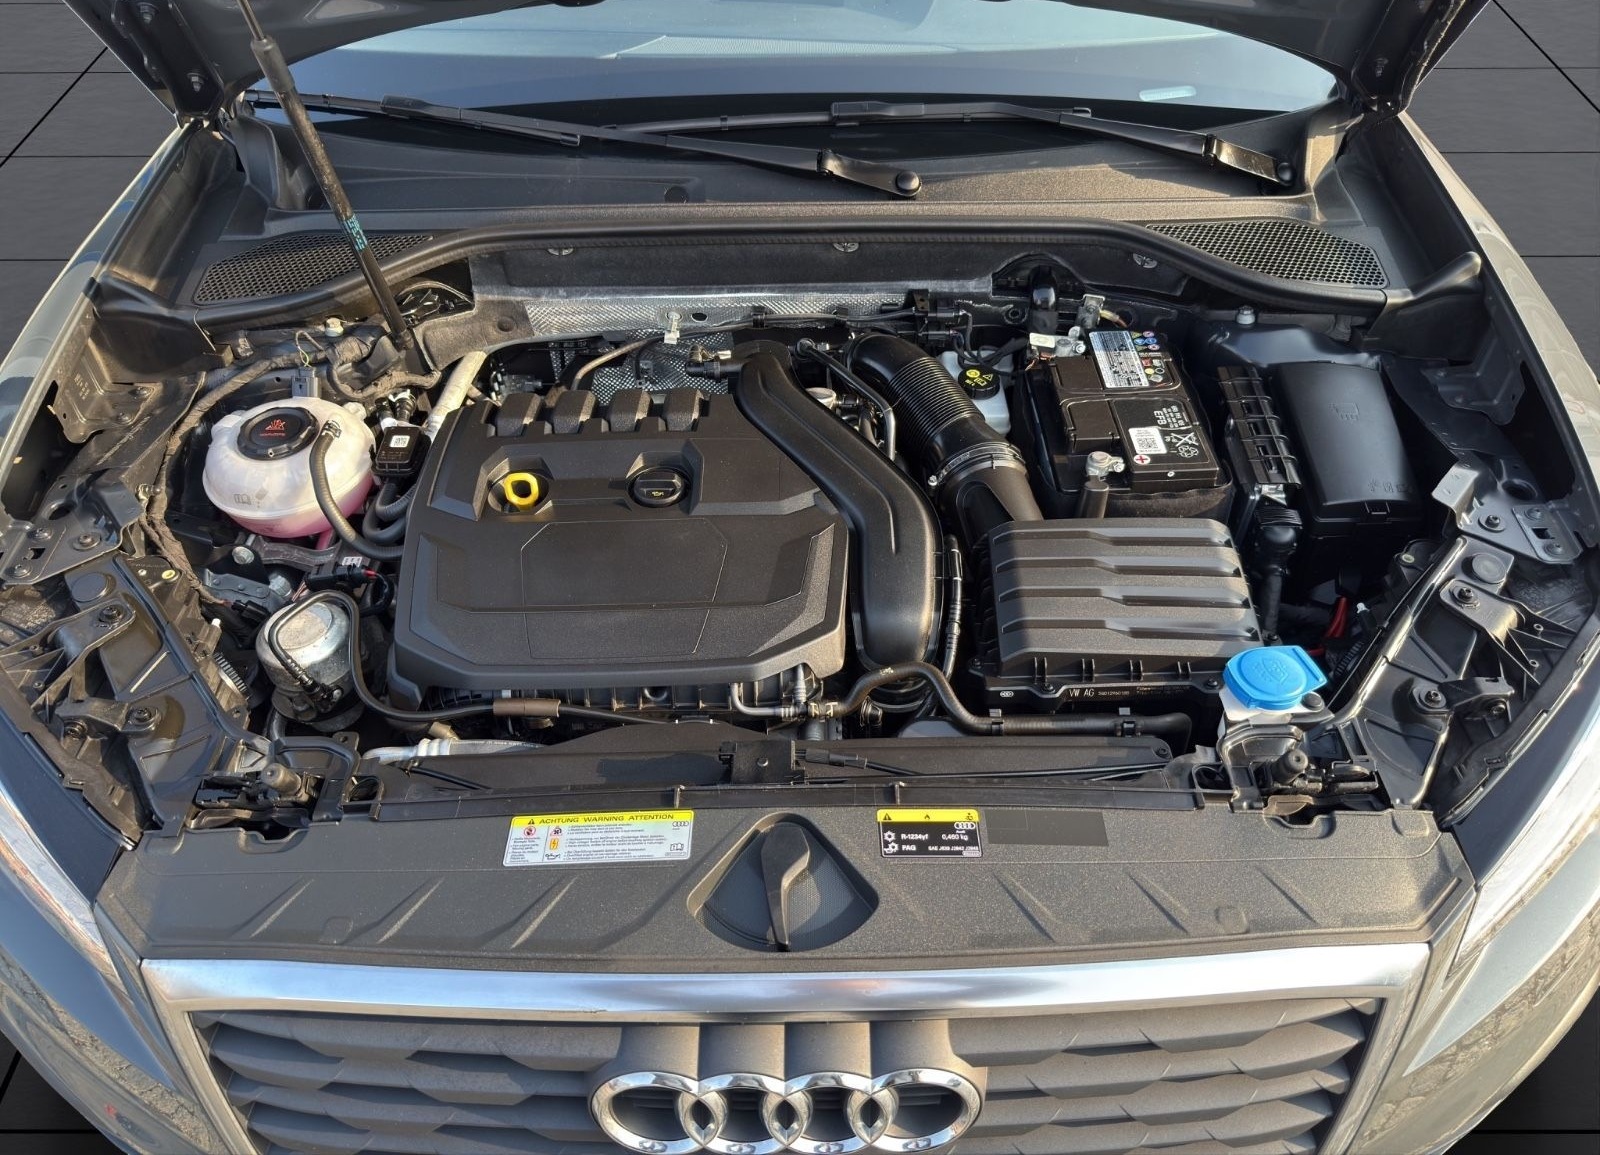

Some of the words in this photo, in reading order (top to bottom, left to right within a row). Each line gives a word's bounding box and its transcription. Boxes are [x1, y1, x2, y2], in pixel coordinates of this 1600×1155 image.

[1153, 410, 1167, 425] EFB
[1069, 688, 1080, 698] VW
[1084, 688, 1095, 697] AG
[583, 815, 624, 823] WARNING
[901, 833, 928, 841] R-1234yf
[961, 833, 969, 841] kg
